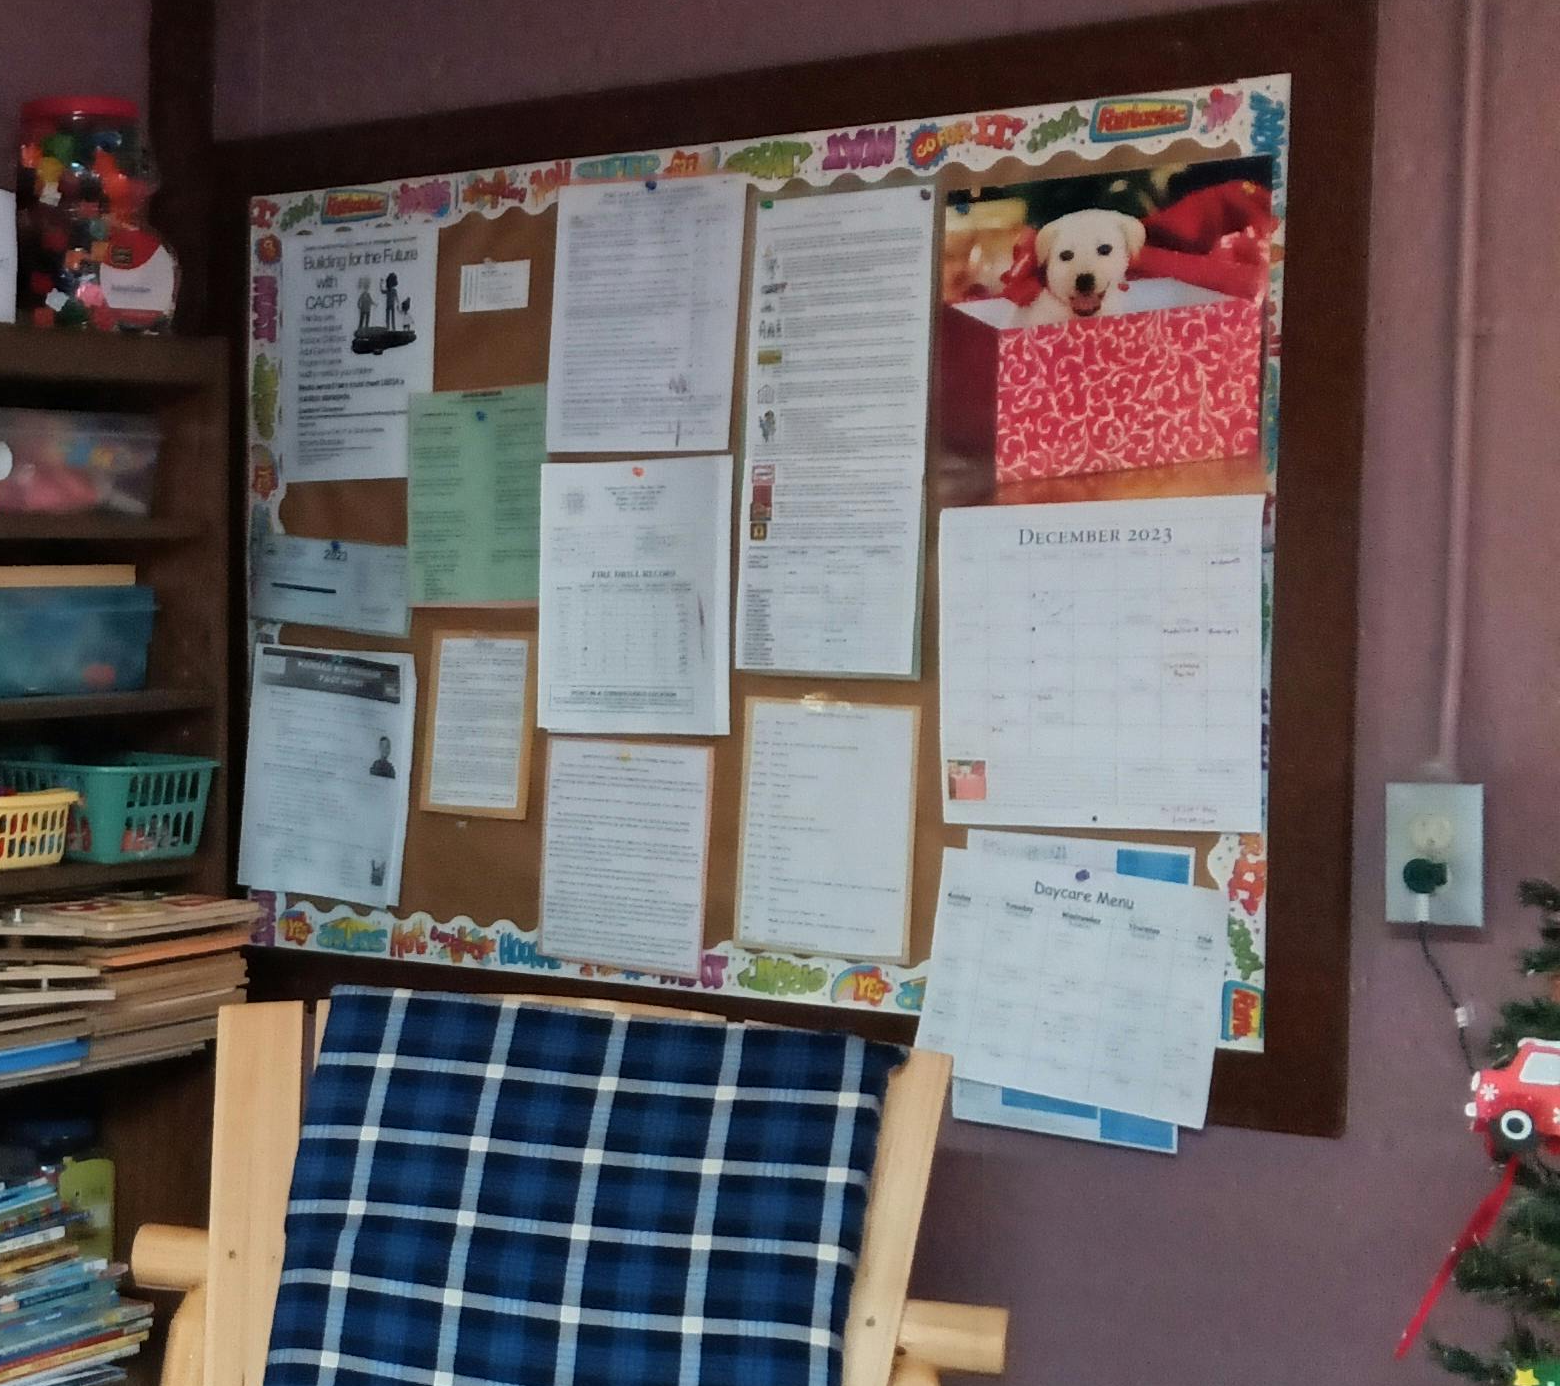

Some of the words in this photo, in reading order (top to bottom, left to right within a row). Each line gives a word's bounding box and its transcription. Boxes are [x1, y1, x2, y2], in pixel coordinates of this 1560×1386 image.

[916, 137, 937, 158] GO
[304, 255, 346, 271] Building
[348, 252, 362, 266] for
[364, 251, 381, 265] the
[383, 247, 418, 263] Future
[316, 275, 338, 288] with
[305, 293, 348, 310] CACFP
[1018, 528, 1121, 546] DECEMBER
[1127, 527, 1173, 544] 2023
[1034, 880, 1092, 904] Daycare
[1097, 891, 1135, 911] Menu
